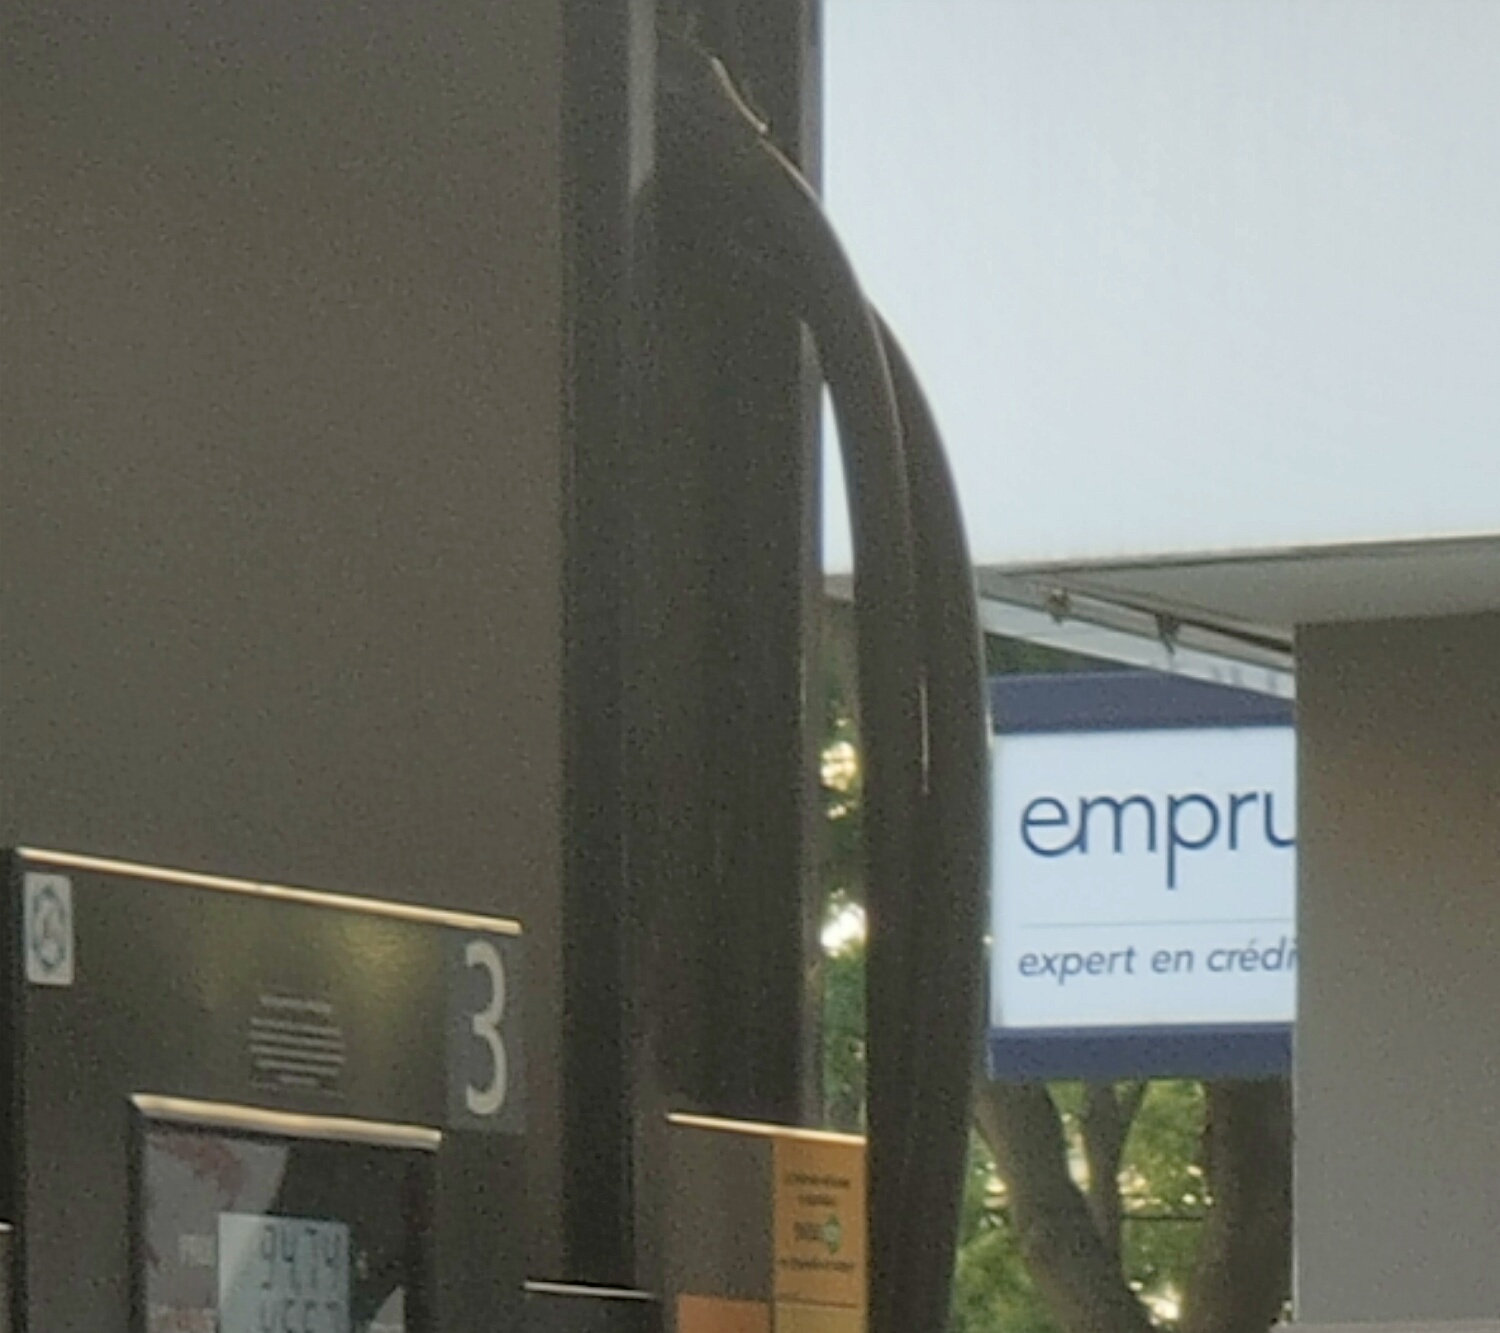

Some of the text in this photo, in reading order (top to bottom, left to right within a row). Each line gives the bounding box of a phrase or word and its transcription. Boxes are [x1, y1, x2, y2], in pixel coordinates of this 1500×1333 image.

[1018, 945, 1136, 986] expert
[1150, 949, 1194, 974] en
[465, 940, 507, 1116] 3
